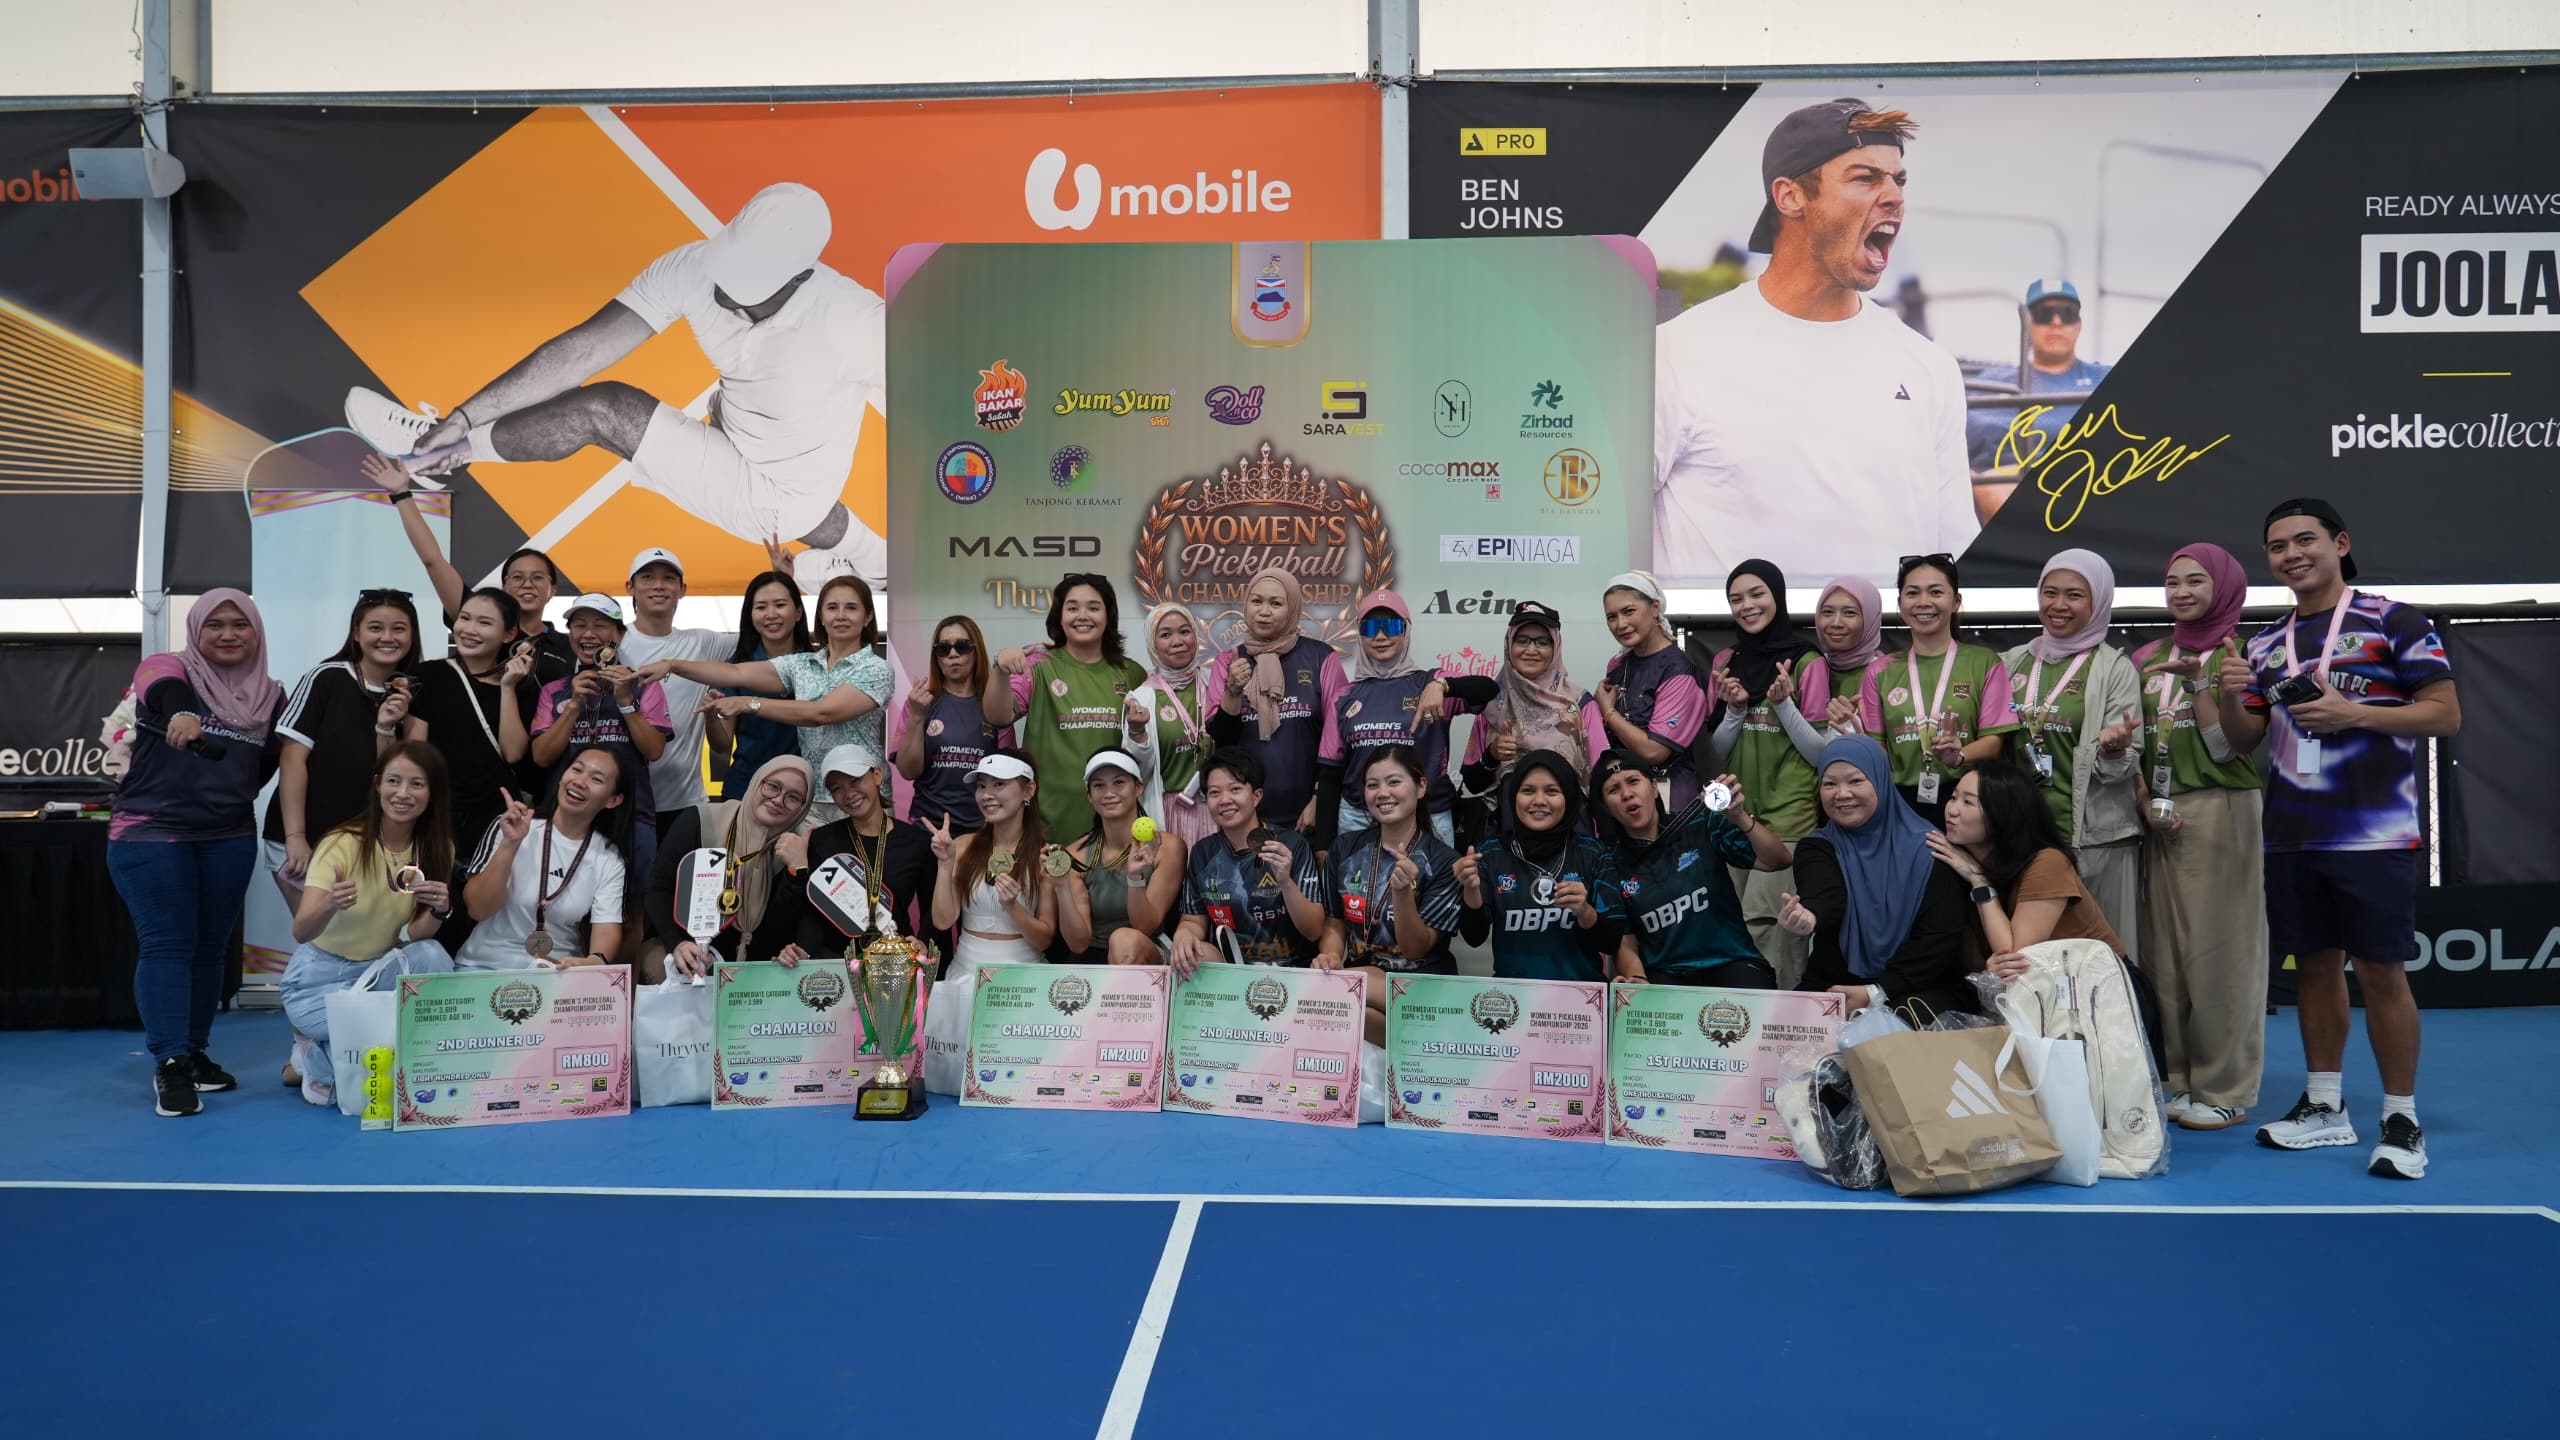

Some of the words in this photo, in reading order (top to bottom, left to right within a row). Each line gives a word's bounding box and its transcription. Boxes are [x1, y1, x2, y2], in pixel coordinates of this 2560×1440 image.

[1496, 134, 1535, 149] PRO
[0, 168, 101, 202] obil
[1110, 168, 1292, 216] mobile
[1461, 179, 1519, 201] BEN
[2365, 195, 2455, 217] READY
[1460, 206, 1564, 229] JOHNS
[2370, 250, 2560, 318] JOOLA
[982, 387, 1014, 401] IKAN
[977, 397, 1023, 413] BAKAR
[986, 410, 1014, 421] Sabah
[1520, 414, 1574, 429] Zirbad
[1303, 422, 1385, 436] SARAVEST
[1519, 430, 1573, 439] Resources
[1399, 461, 1500, 477] cocomax
[1025, 497, 1073, 507] TANJONG
[1075, 497, 1122, 507] KERAMAT
[1178, 515, 1347, 545] WOMEN'S
[949, 536, 1102, 558] MASD
[1180, 544, 1347, 578] Pickleball
[984, 576, 1055, 614] Thry
[1177, 583, 1352, 602] CHAMSHIP
[1072, 706, 1117, 715] WOMEN'S
[1241, 710, 1312, 722] CHAONSHIP
[1059, 721, 1122, 730] CHAMPIONSH
[1353, 721, 1402, 732] WOMEN'S
[940, 745, 985, 757] WOMEN'S
[1639, 886, 1710, 934] DBPC
[1504, 907, 1576, 933] DBPC
[2344, 926, 2560, 972] OLA
[553, 998, 581, 1006] WOMEN'S
[582, 996, 617, 1004] PICKLEBALL
[553, 1005, 597, 1013] CHAMPIONSHIP
[1401, 1005, 1438, 1014] INTERMEDIATE
[1438, 1007, 1464, 1015] CATEGORY
[1530, 1012, 1557, 1020] WOMEN'S
[1558, 1013, 1592, 1022] PICKLEBALL
[1626, 1010, 1653, 1019] VETERAN
[1654, 1011, 1684, 1020] CATEGORY
[749, 1020, 837, 1036] CHAMPION
[1001, 1023, 1082, 1038] CHAMPION
[1530, 1020, 1573, 1029] CHAMPIONSHIP
[1625, 1026, 1657, 1036] COMBINED
[1658, 1027, 1669, 1036] AGE
[1762, 1024, 1791, 1033] WOMEN'S
[1792, 1025, 1829, 1035] PICKLEBALL
[437, 1039, 465, 1051] 2ND
[468, 1036, 524, 1050] RUNNER
[527, 1034, 545, 1047] UP
[1200, 1026, 1223, 1038] 2ND
[1225, 1028, 1271, 1043] RUNNER
[1274, 1031, 1290, 1044] UP
[1761, 1033, 1808, 1041] CHAMPIONSHIP
[655, 1042, 710, 1059] Thryve
[925, 1035, 959, 1056] Thryve
[1422, 1041, 1446, 1053] 1ST
[1447, 1043, 1500, 1057] RUNNER
[1502, 1045, 1521, 1058] UP
[562, 1052, 610, 1069] RM800
[1099, 1047, 1149, 1063] RM2000
[1296, 1056, 1344, 1074] RM1000
[1647, 1055, 1670, 1067] 1ST
[1672, 1056, 1728, 1071] RUNNER
[1730, 1059, 1750, 1073] UP
[370, 1053, 378, 1116] FACOLOS
[412, 1074, 434, 1083] EIGHT
[435, 1072, 470, 1082] HUNDRED
[471, 1071, 491, 1080] ONLY
[1533, 1070, 1589, 1088] RM2000
[1638, 1091, 1675, 1100] THOUSAND
[1676, 1093, 1695, 1102] ONLY
